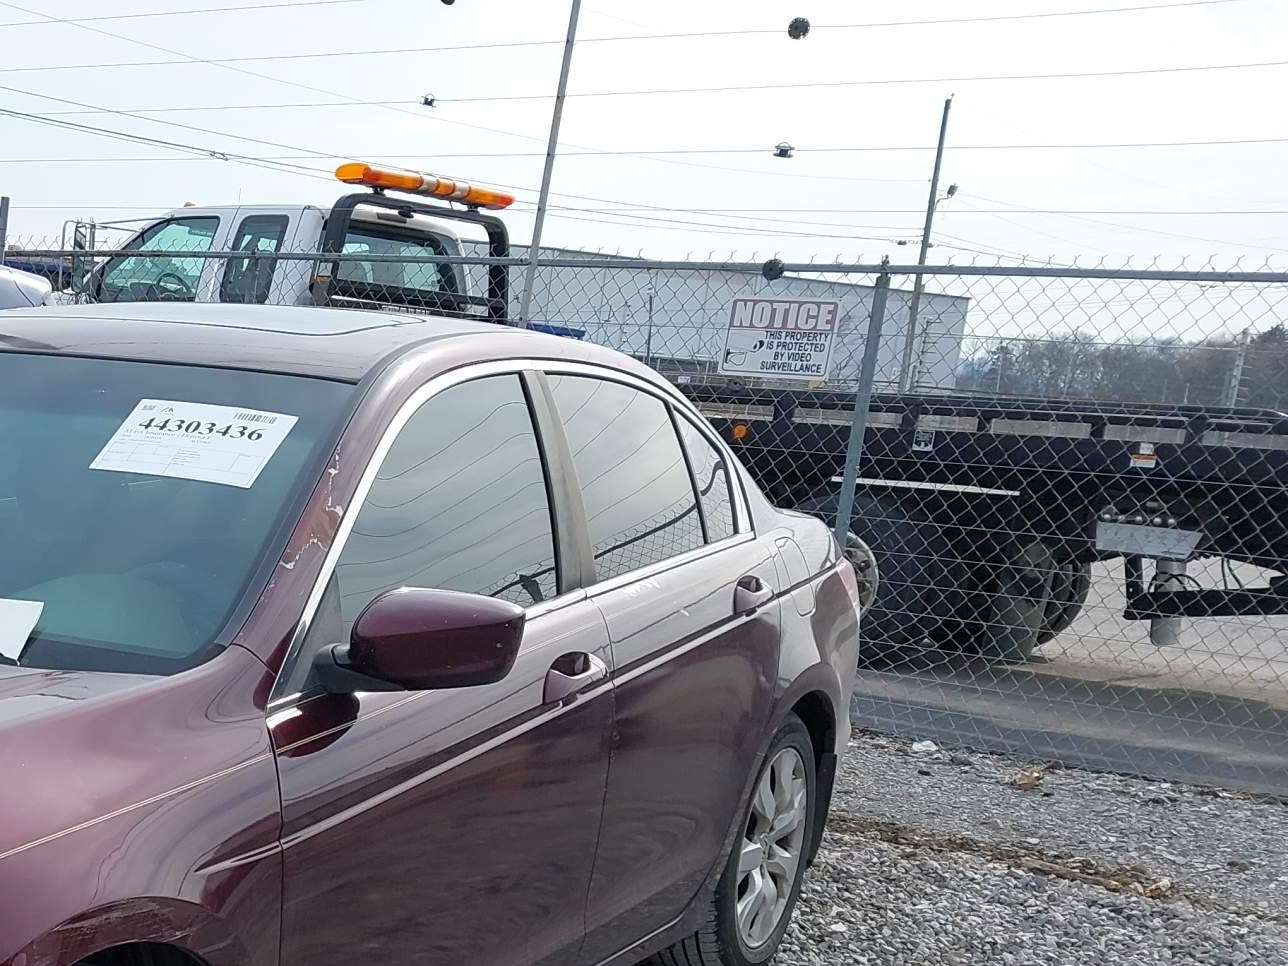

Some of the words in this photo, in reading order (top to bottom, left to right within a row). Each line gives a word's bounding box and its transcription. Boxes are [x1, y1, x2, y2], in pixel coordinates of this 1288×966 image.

[733, 300, 834, 330] NOTICE
[765, 331, 783, 340] THIS
[784, 331, 830, 342] PROPERTY
[766, 341, 774, 350] IS
[775, 341, 825, 352] PROTECTED
[773, 351, 785, 361] BY
[787, 352, 812, 362] VIDEO
[760, 361, 822, 374] SURVEILLANCE
[138, 416, 265, 442] 44303436
